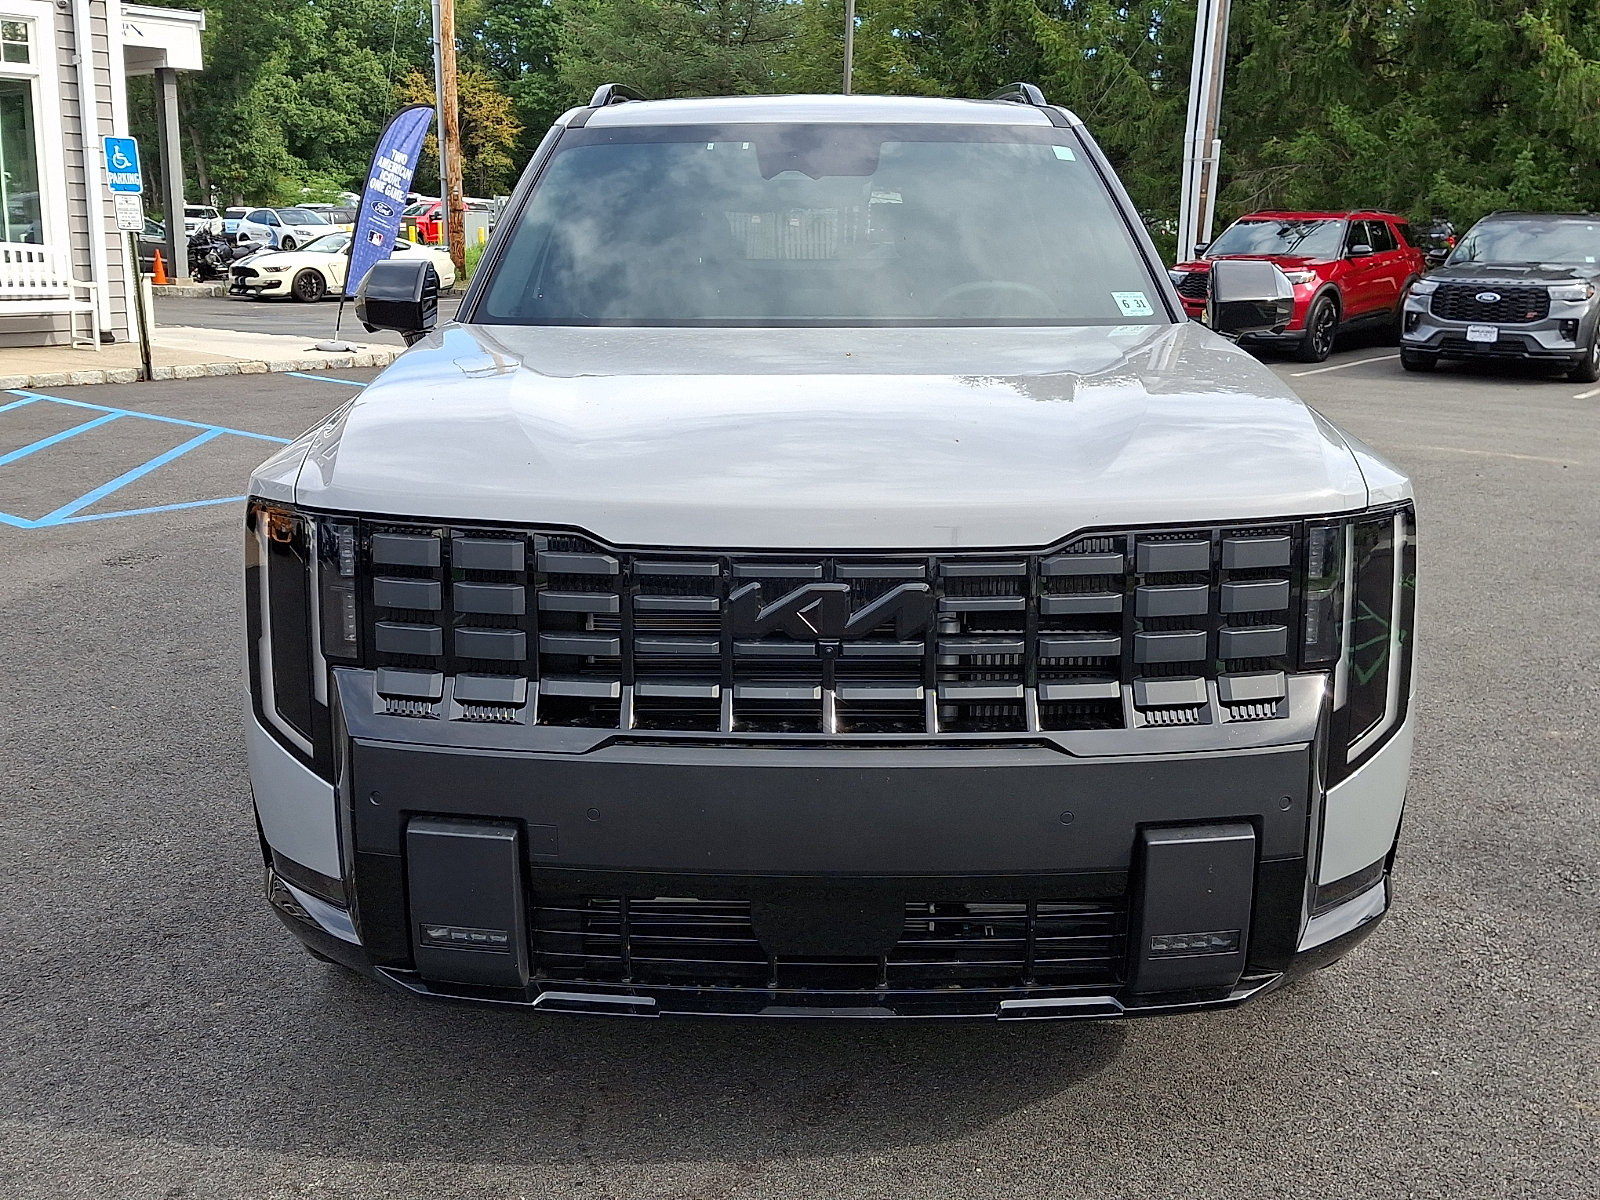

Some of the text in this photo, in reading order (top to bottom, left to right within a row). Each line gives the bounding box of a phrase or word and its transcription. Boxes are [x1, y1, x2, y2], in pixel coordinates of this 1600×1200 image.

[391, 149, 408, 166] TWO
[377, 156, 413, 181] AMERICAN
[108, 172, 140, 185] PARKING
[370, 177, 386, 194] ONE
[1122, 299, 1147, 309] 6 31
